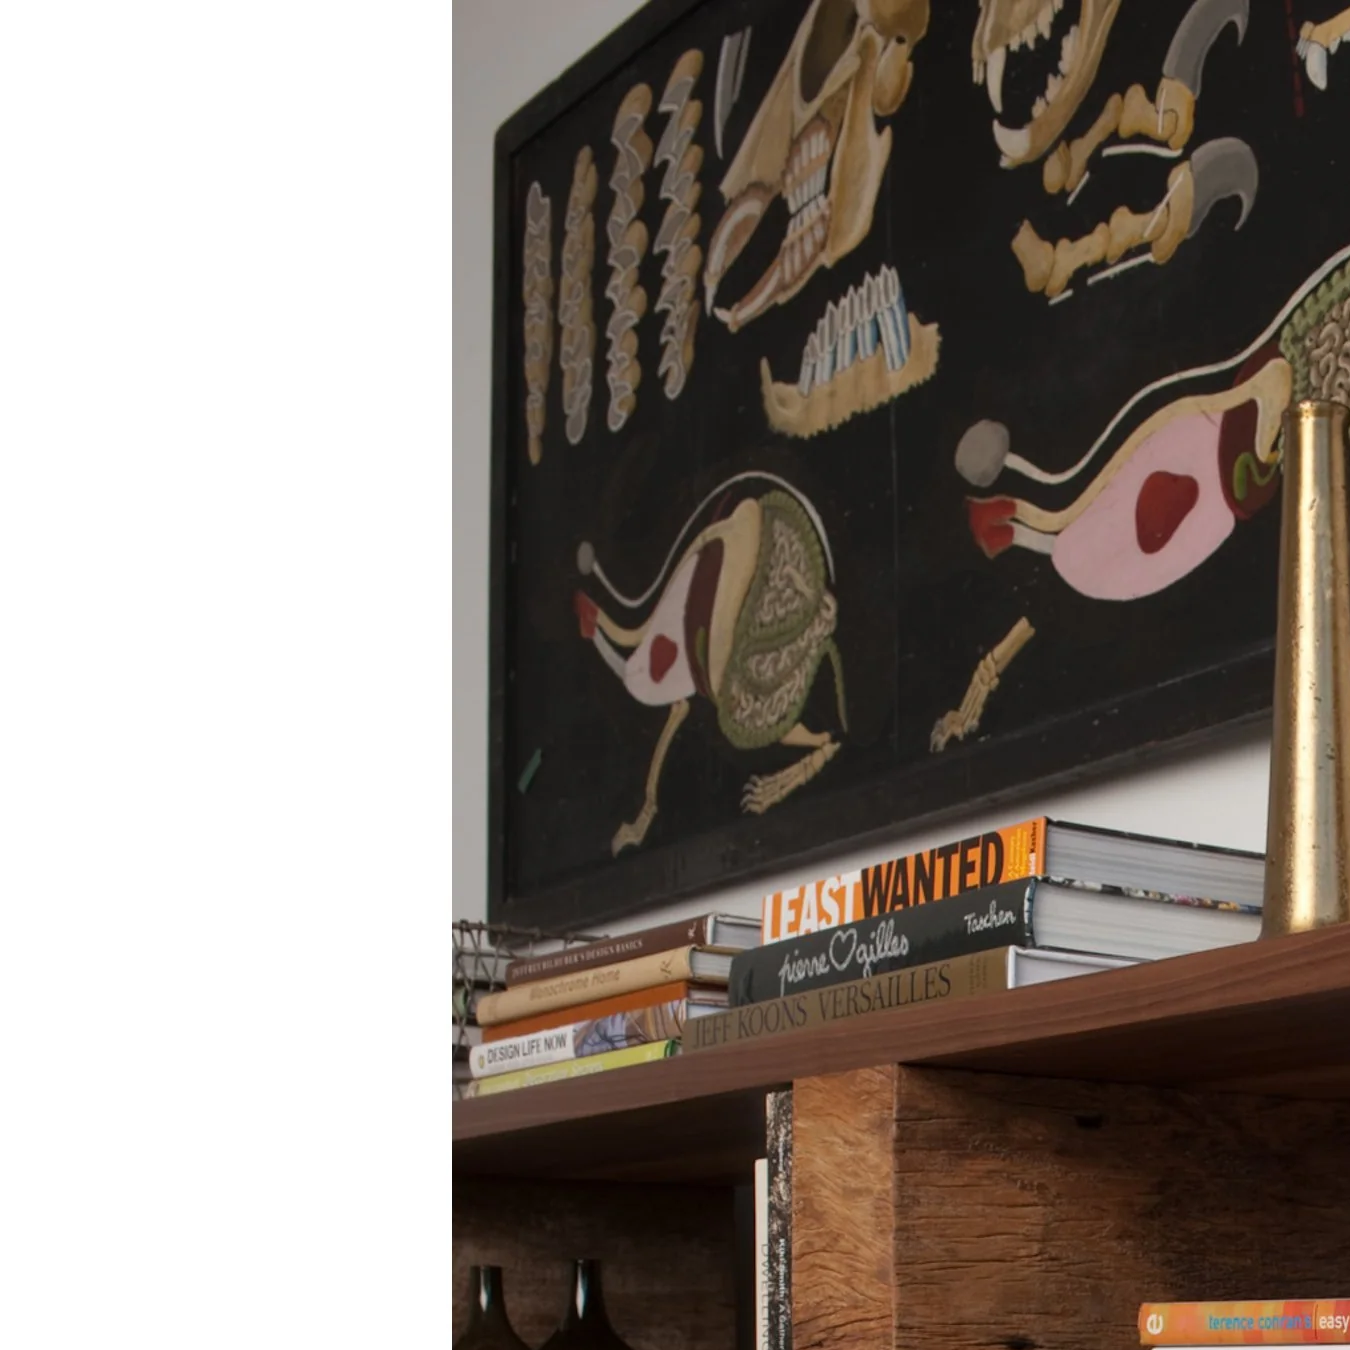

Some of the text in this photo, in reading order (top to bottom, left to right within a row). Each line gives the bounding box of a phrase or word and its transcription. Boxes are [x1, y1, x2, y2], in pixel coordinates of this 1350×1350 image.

[763, 869, 862, 945] LEAST
[860, 832, 1004, 919] WANTED
[615, 938, 643, 953] BASICS
[778, 949, 830, 996] pierre
[856, 918, 909, 977] gilles
[590, 969, 620, 987] Home
[695, 1015, 731, 1050] JEFF
[737, 997, 808, 1041] KOONS
[816, 963, 951, 1022] VERSAILLES
[487, 1041, 521, 1065] DESIGN
[521, 1036, 542, 1057] LIFE
[542, 1031, 567, 1052] NOW
[1208, 1314, 1255, 1330] terence
[1258, 1314, 1312, 1330] conran's
[1318, 1311, 1350, 1333] easy
